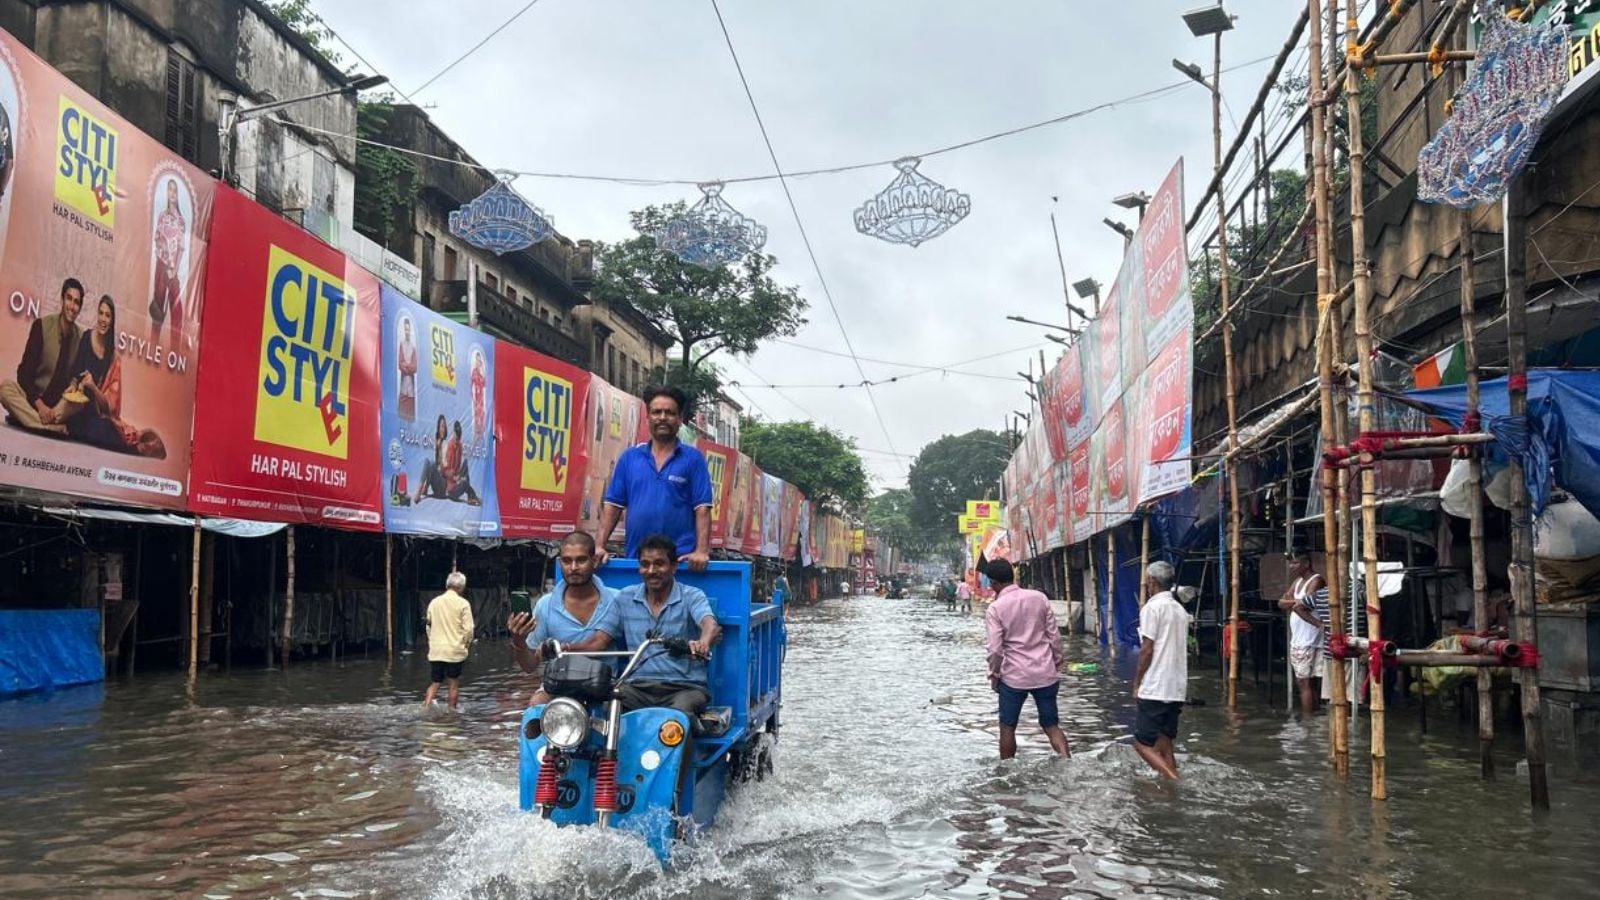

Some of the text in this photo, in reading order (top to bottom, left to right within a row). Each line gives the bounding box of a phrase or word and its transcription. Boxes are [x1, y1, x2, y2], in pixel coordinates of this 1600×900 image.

[62, 107, 115, 170] CITI
[60, 145, 112, 216] STYLE
[53, 203, 114, 243] HAR PAL STYLISH
[9, 291, 187, 372] ON STYLE ON
[271, 263, 355, 359] CITI
[432, 326, 454, 353] CITI
[264, 335, 346, 446] STYLE
[526, 375, 571, 430] CITI
[22, 457, 65, 474] RASHBEHARI
[66, 466, 93, 478] AVENUE
[251, 454, 347, 488] HAR PAL STYLISH
[525, 423, 567, 486] STYLE
[518, 496, 531, 509] HAR
[531, 497, 543, 511] PAL
[558, 786, 576, 802] 70
